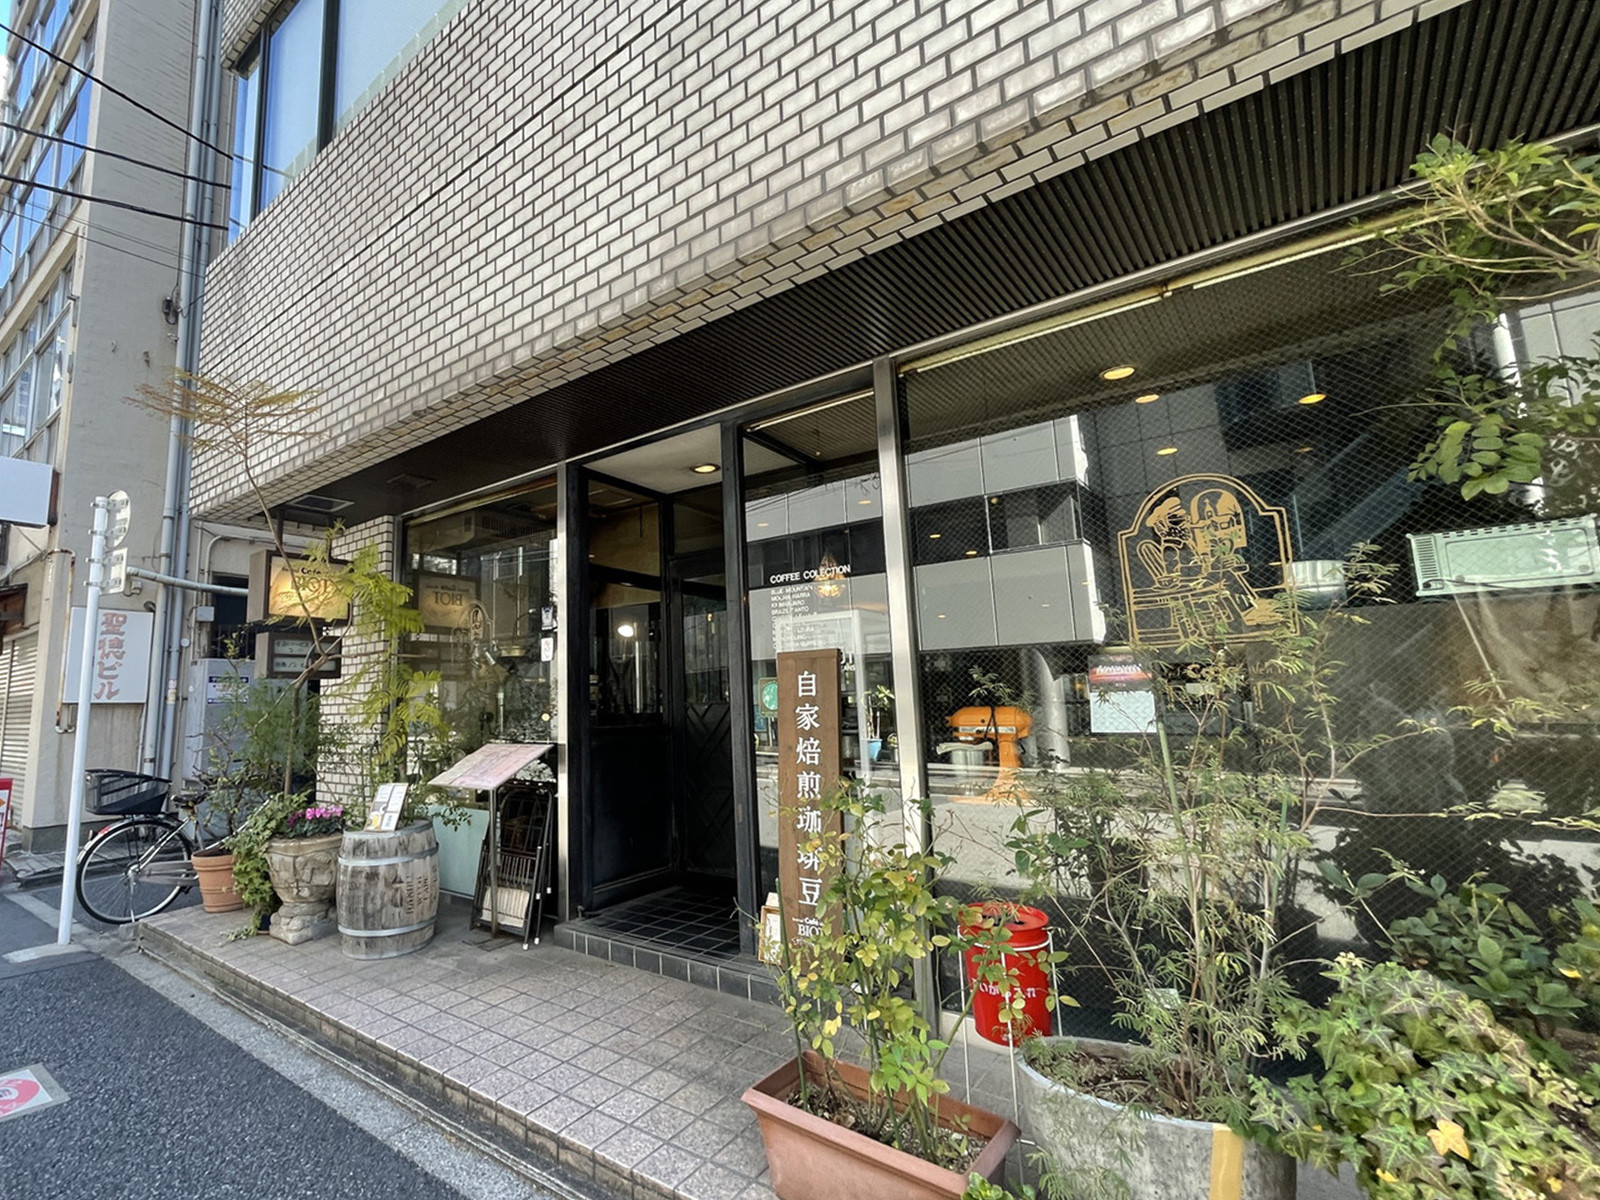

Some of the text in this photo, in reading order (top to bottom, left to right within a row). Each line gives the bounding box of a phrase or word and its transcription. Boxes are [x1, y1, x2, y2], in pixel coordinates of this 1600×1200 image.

[770, 572, 801, 584] COFFEE
[93, 612, 128, 700] 聖徳ビル
